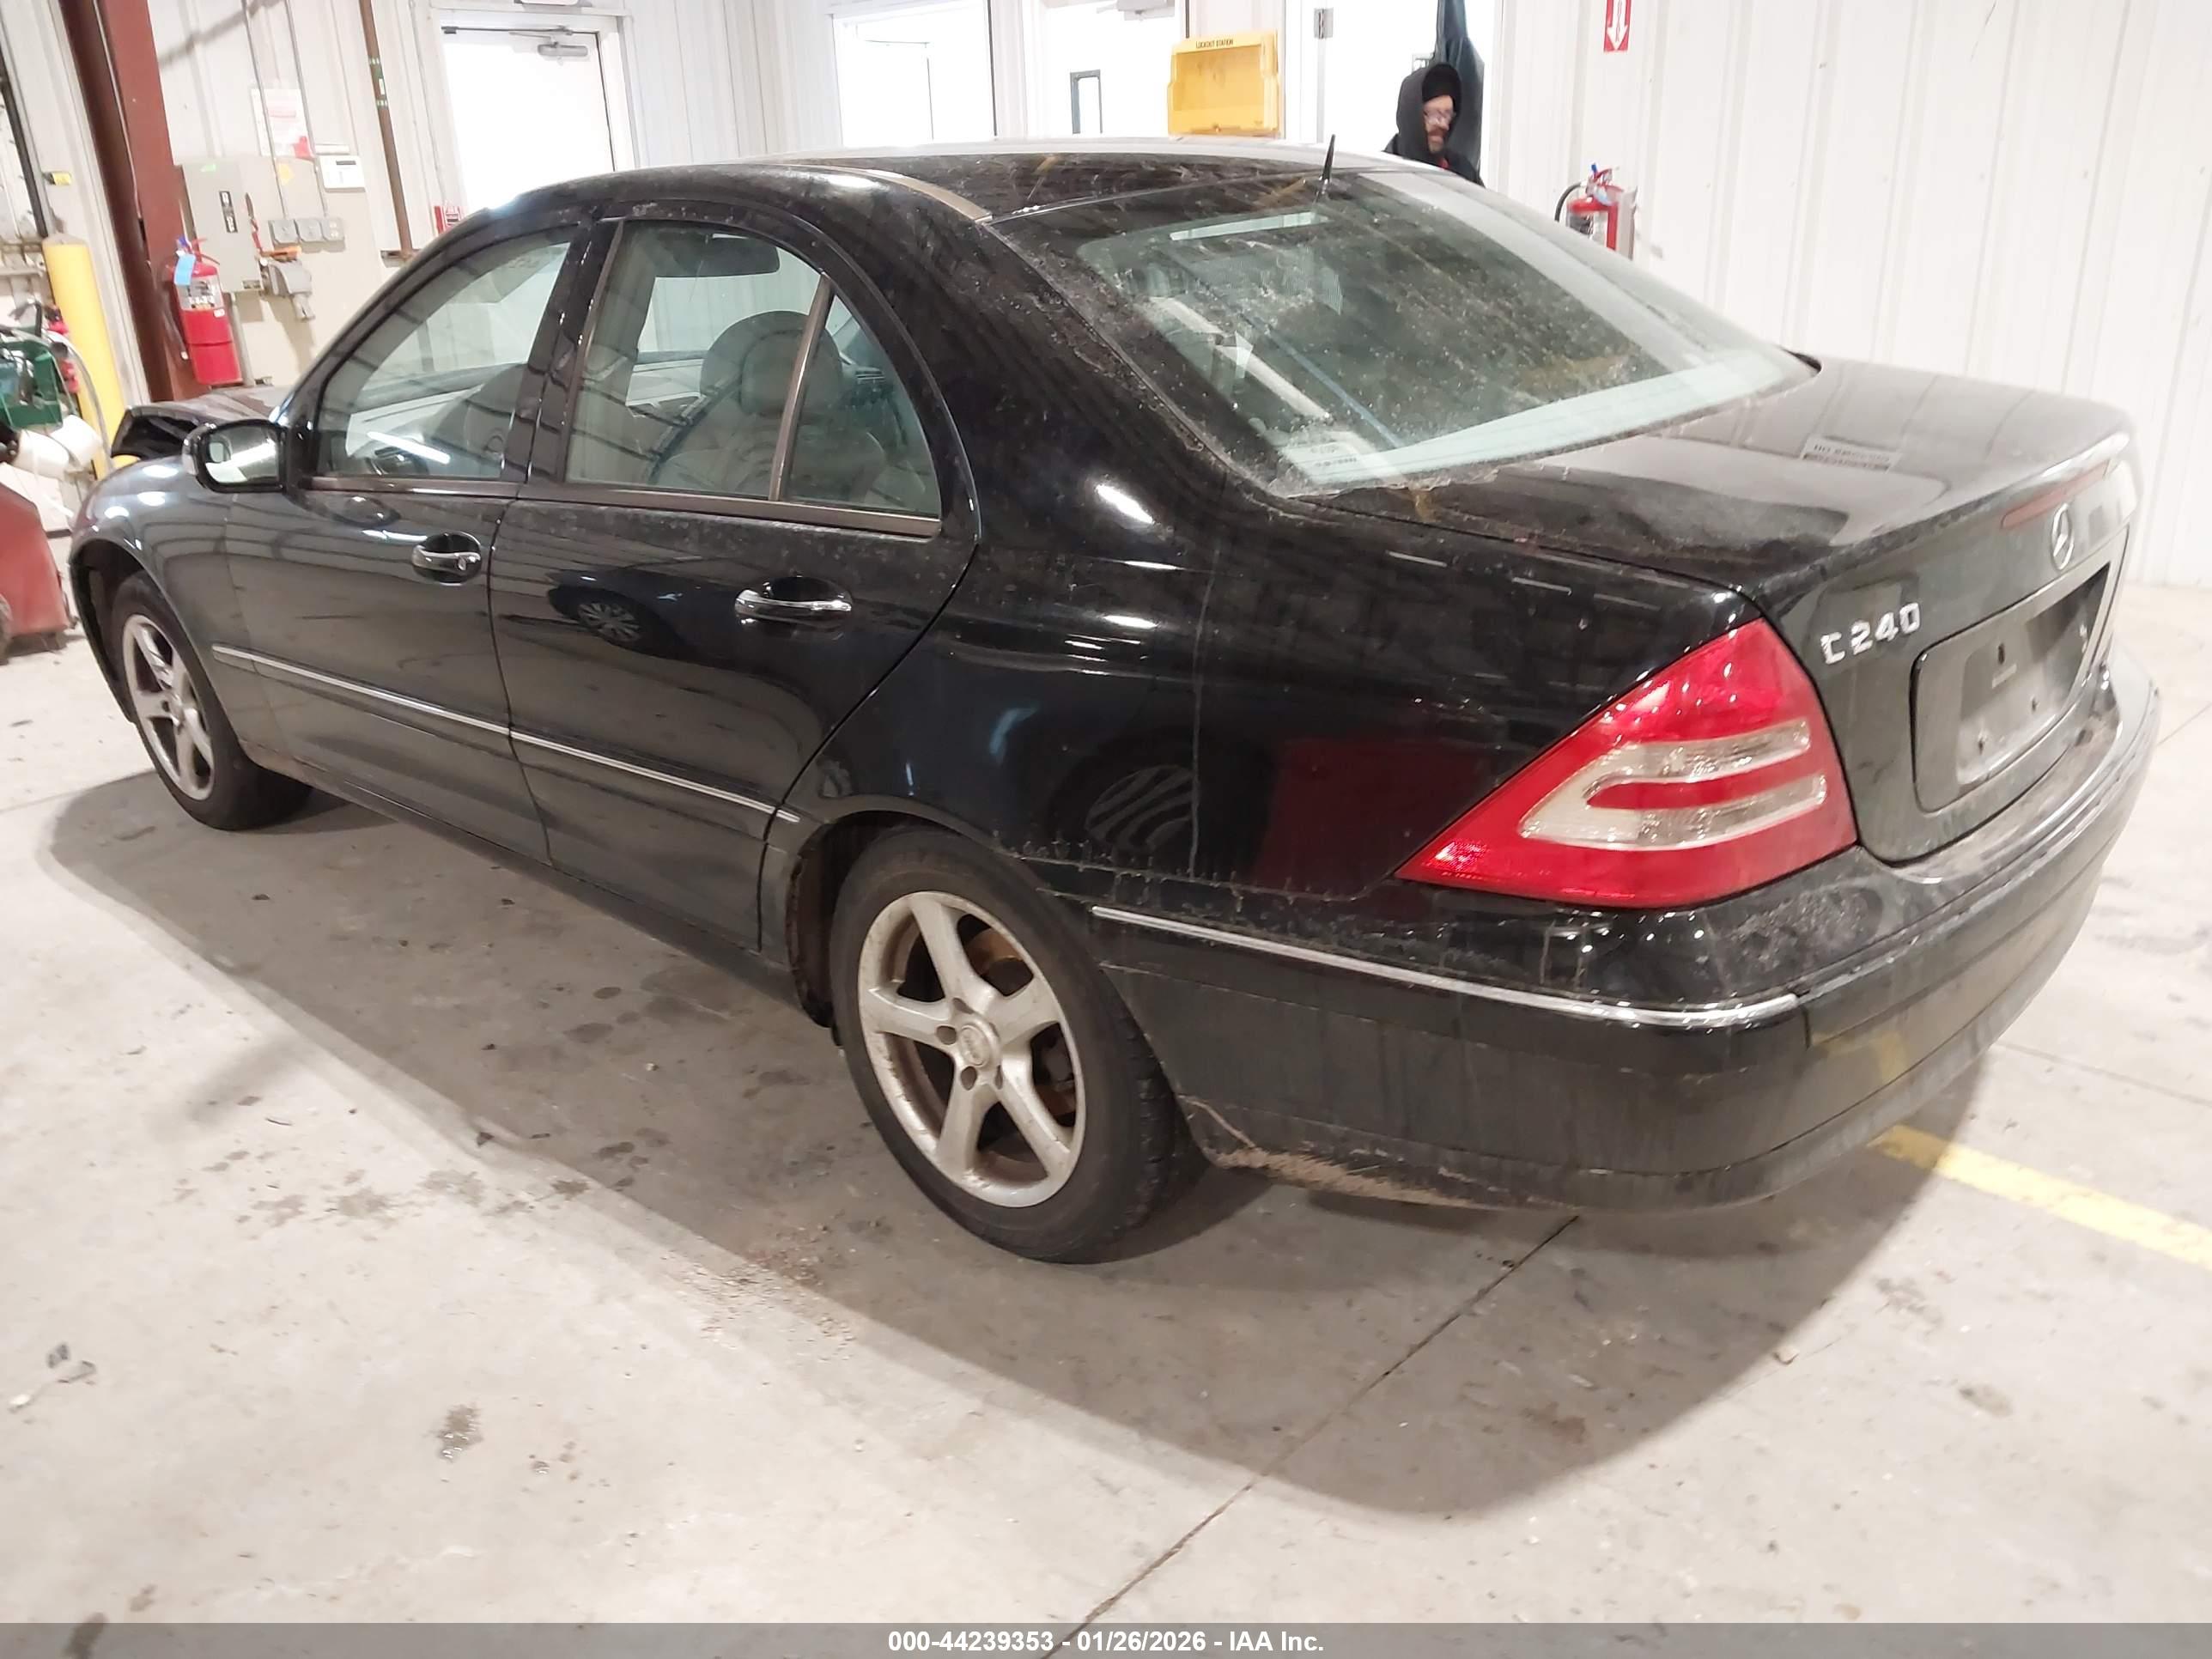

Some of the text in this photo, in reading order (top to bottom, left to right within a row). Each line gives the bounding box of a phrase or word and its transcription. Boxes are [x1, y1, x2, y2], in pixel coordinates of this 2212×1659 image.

[1195, 39, 1234, 49] LOCKOUT STATION
[1820, 602, 1921, 665] C 240
